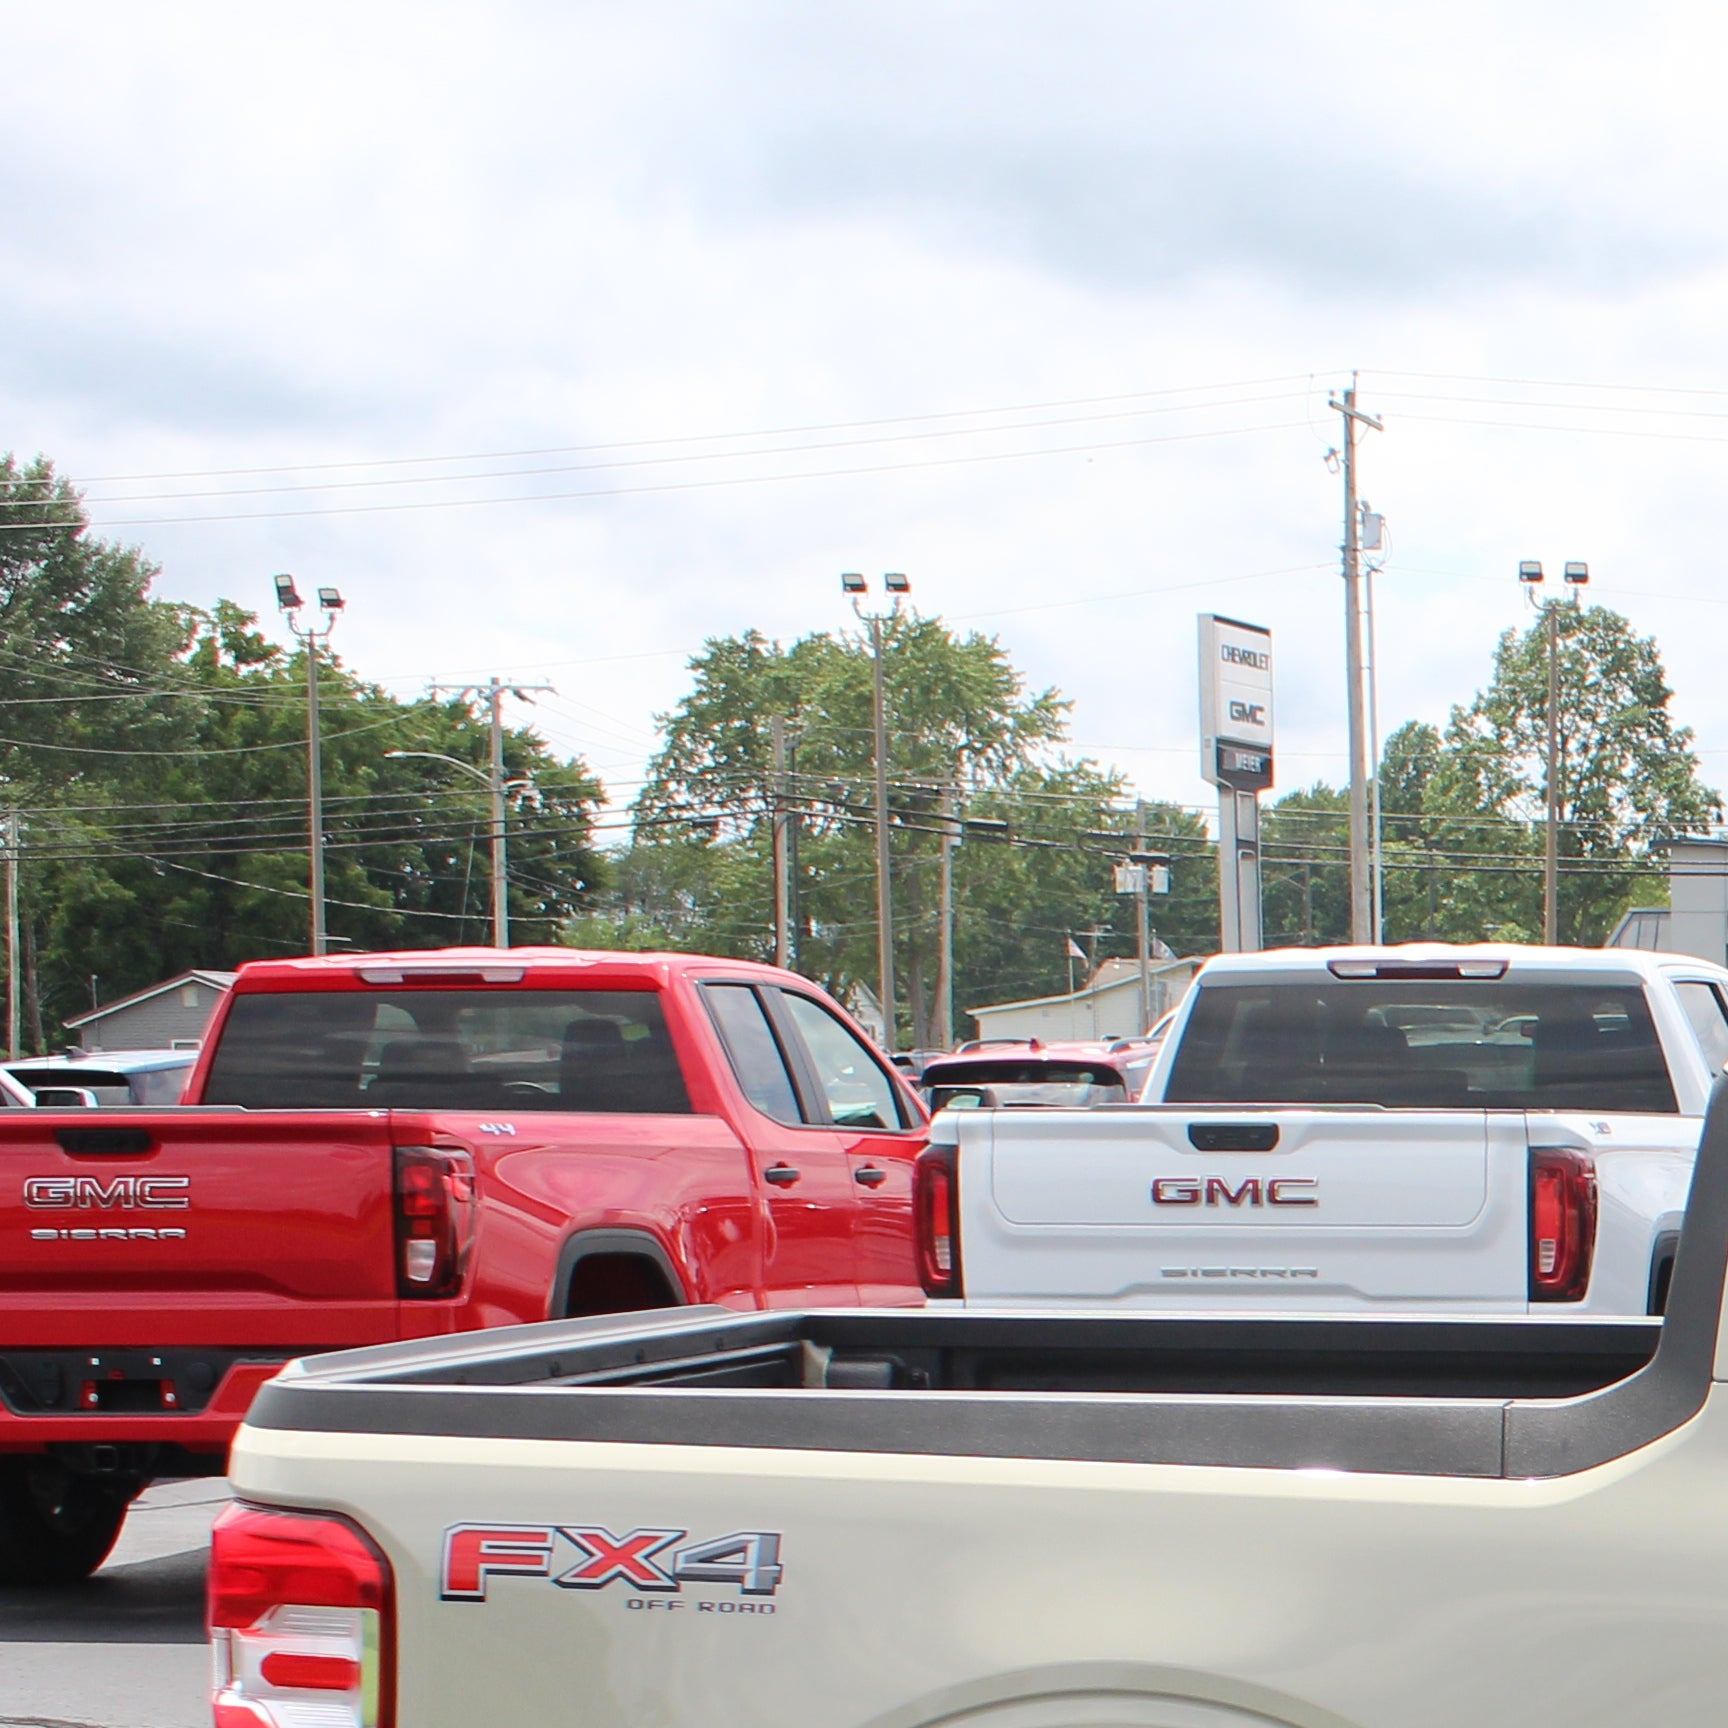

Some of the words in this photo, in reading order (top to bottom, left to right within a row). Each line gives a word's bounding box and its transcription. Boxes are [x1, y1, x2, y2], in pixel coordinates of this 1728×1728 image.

[1221, 643, 1269, 671] CHEVROLET
[1229, 700, 1265, 726] GMC
[24, 1177, 190, 1209] GMC
[1152, 1175, 1319, 1207] GMC
[30, 1228, 186, 1240] SIERRA
[1160, 1266, 1318, 1279] SIERRA
[439, 1522, 784, 1602] FX4
[627, 1598, 687, 1611] OFF
[697, 1601, 776, 1614] ROAD
